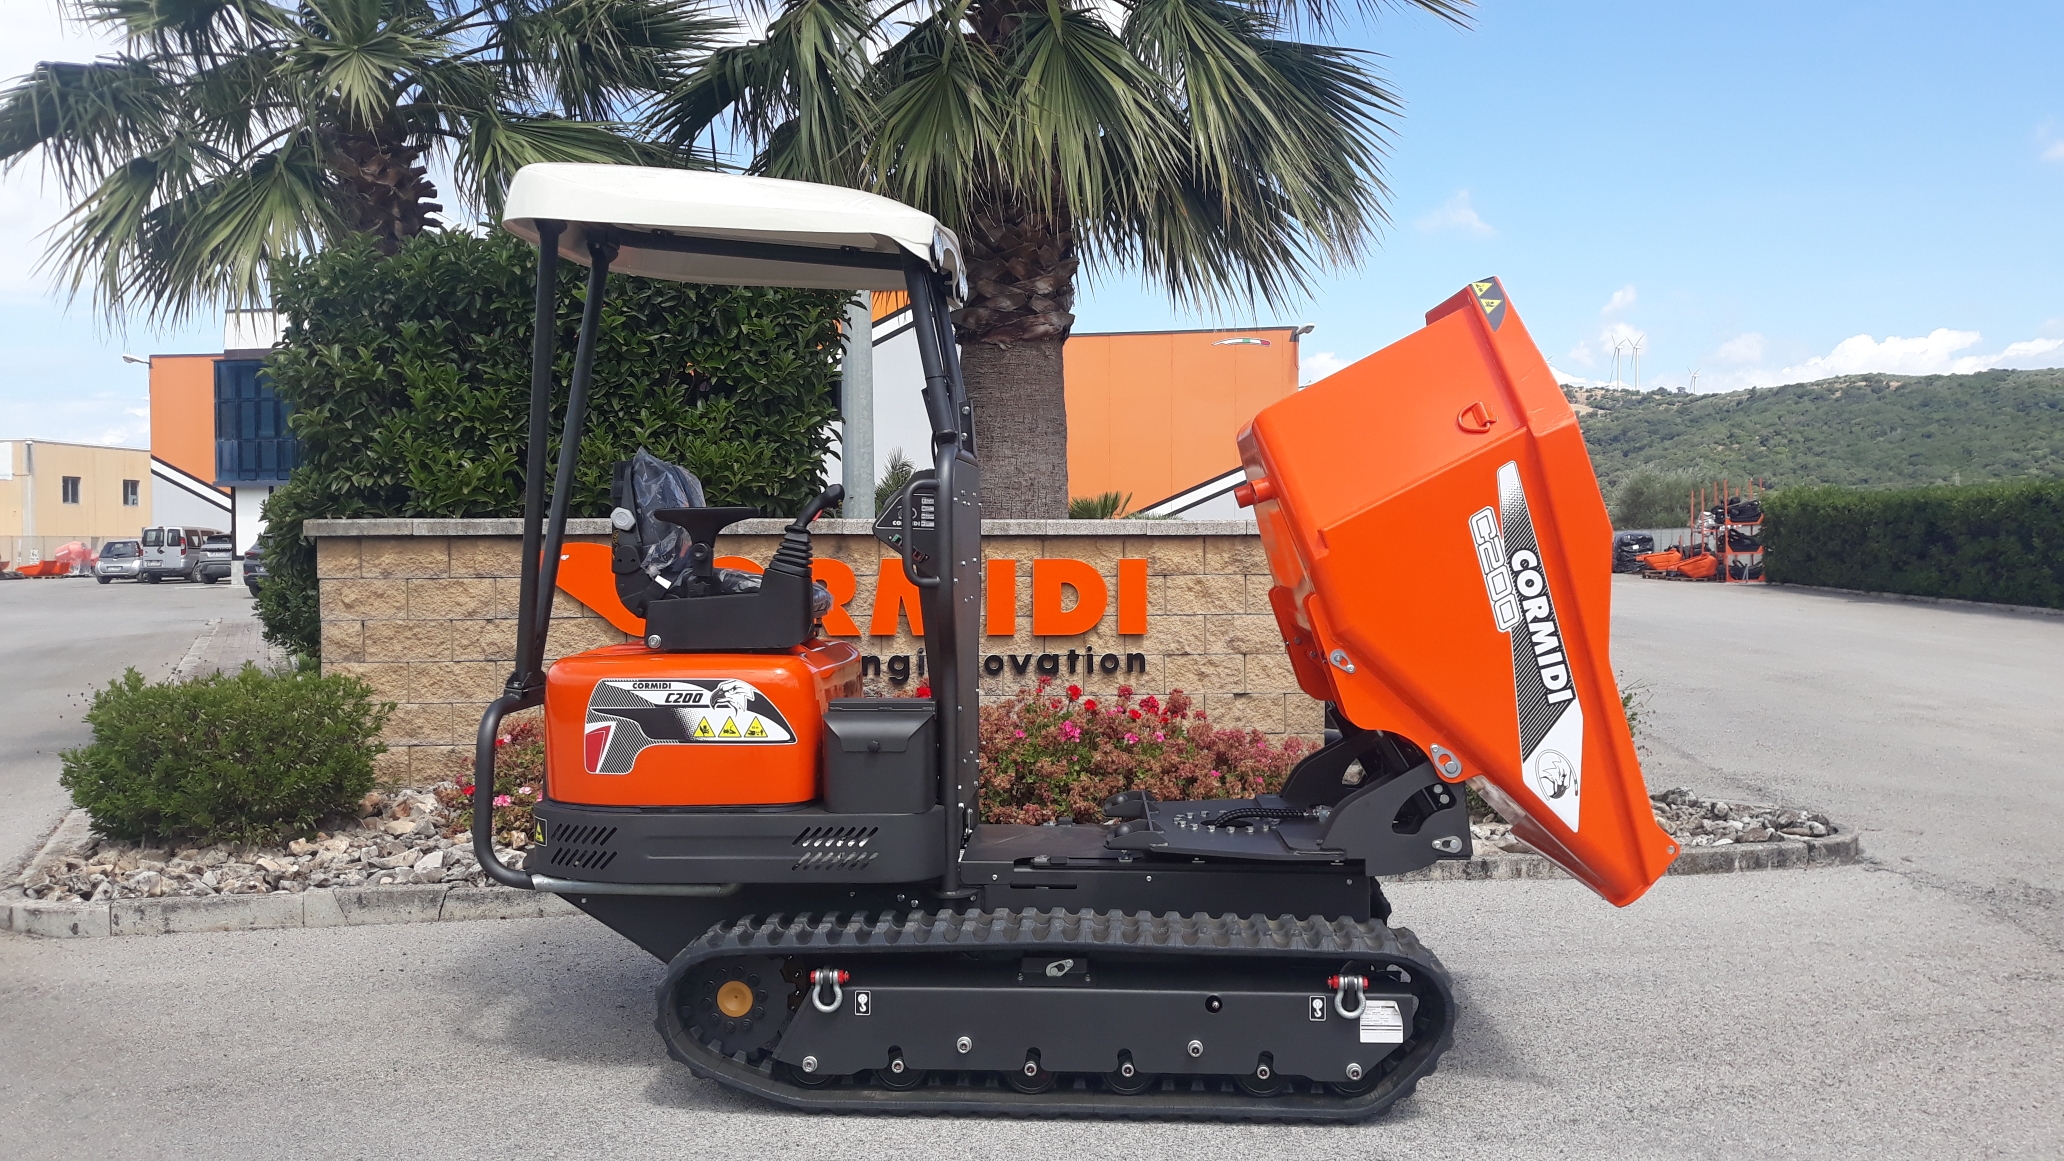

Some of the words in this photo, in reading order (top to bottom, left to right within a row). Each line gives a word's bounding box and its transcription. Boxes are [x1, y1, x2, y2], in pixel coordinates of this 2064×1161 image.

[542, 541, 1147, 637] RIDI
[1468, 505, 1522, 634] C200
[1509, 547, 1576, 706] CORMIDI
[632, 682, 672, 690] CORMIDI
[664, 692, 704, 704] C200
